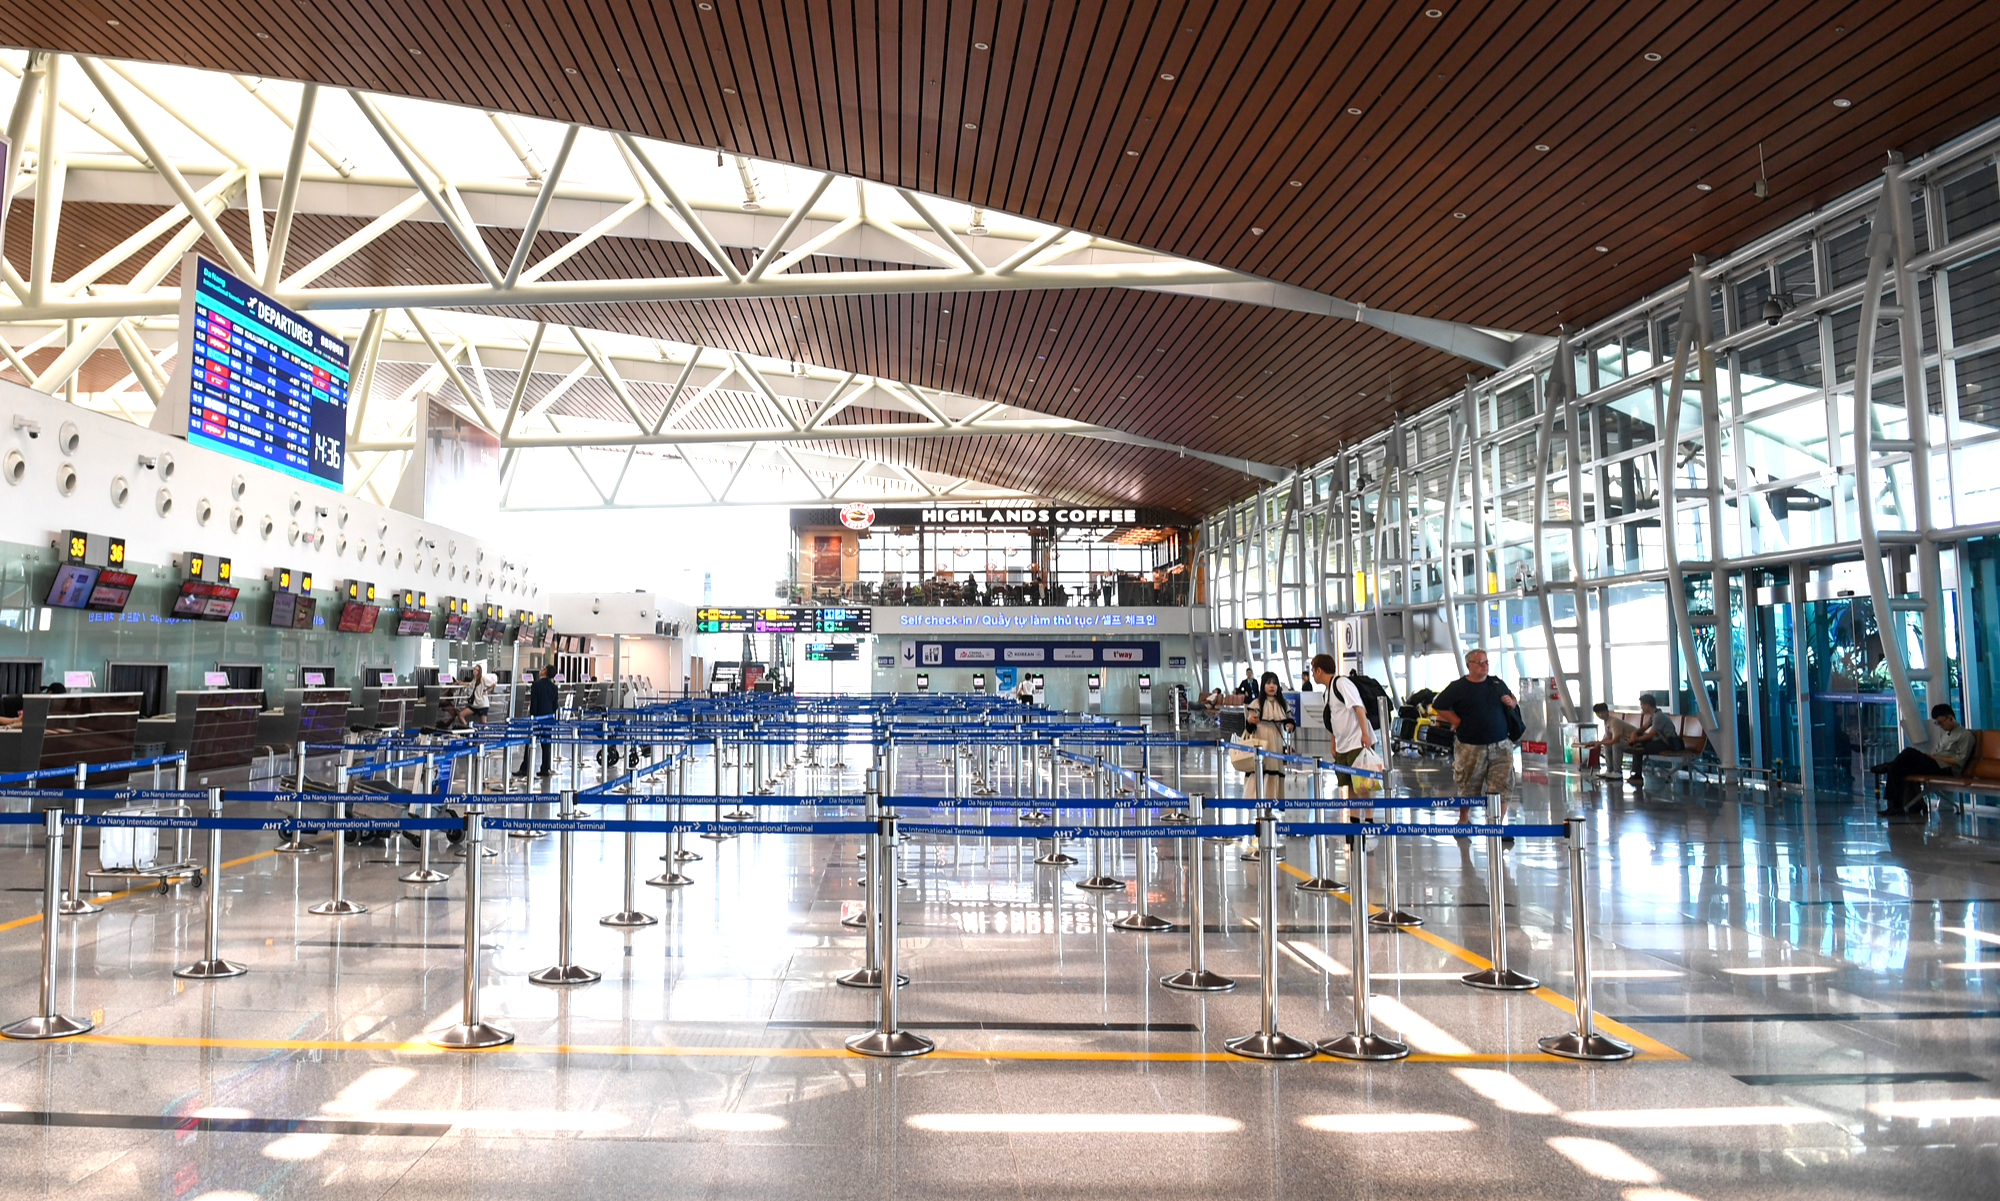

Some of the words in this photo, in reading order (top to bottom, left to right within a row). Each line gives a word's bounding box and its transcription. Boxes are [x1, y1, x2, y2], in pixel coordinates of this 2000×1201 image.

[211, 271, 226, 288] Nang
[257, 301, 313, 348] DEPARTURES
[314, 432, 341, 470] 14:36
[922, 509, 1050, 523] HIGHLANDS
[1055, 509, 1136, 523] COFFEE
[71, 537, 85, 557] 35
[110, 544, 124, 563] 36
[191, 558, 203, 575] 37
[219, 563, 230, 580] 38
[900, 614, 923, 626] Self
[924, 614, 973, 626] check-in
[974, 614, 980, 626] /
[982, 611, 1011, 629] Quầy
[1014, 614, 1029, 629] tự
[1030, 614, 1051, 626] làm
[1053, 613, 1072, 626] thủ
[1074, 614, 1094, 629] tục
[1094, 614, 1100, 626] /
[1101, 613, 1122, 627] 셀프
[1125, 613, 1156, 627] 체크인
[7, 790, 41, 798] International
[115, 791, 130, 801] AHT
[151, 792, 165, 800] Nang
[166, 792, 200, 801] International
[274, 794, 290, 802] AHT
[311, 794, 327, 803] Nang
[328, 794, 364, 802] International
[365, 794, 389, 802] Terminal
[444, 795, 460, 804] AHT
[472, 794, 480, 803] Da
[481, 794, 497, 804] Nang
[498, 794, 534, 803] International
[535, 793, 560, 802] Terminal
[627, 796, 643, 804] AHT
[655, 796, 663, 804] Da
[665, 796, 680, 806] Nang
[681, 796, 718, 805] International
[719, 796, 743, 805] Terminal
[799, 797, 816, 806] AHT
[829, 797, 836, 805] Da
[838, 797, 853, 806] Nang
[938, 799, 955, 807] AHT
[968, 798, 976, 806] Da
[977, 798, 993, 808] Nang
[994, 798, 1031, 807] International
[1032, 799, 1057, 807] Terminal
[1114, 800, 1131, 808] AHT
[1144, 799, 1152, 807] Da
[1154, 799, 1169, 809] Nang
[1255, 800, 1272, 809] AHT
[1284, 799, 1293, 807] Da
[1294, 799, 1310, 809] Nang
[1311, 799, 1347, 808] International
[1349, 799, 1374, 807] Terminal
[1431, 799, 1448, 807] AHT
[1460, 797, 1469, 805] Da
[1470, 797, 1485, 807] Nang
[63, 817, 83, 826] AHT
[97, 817, 106, 826] Da
[106, 818, 125, 829] Nang
[126, 818, 169, 829] International
[169, 819, 198, 830] Terminal
[263, 820, 282, 830] AHT
[297, 820, 306, 829] Da
[307, 820, 325, 831] Nang
[326, 820, 370, 830] International
[371, 821, 399, 830] Terminal
[502, 821, 512, 831] Da
[513, 821, 531, 833] Nang
[532, 822, 576, 832] International
[577, 823, 606, 833] Terminal
[673, 824, 692, 834] AHT
[707, 824, 716, 833] Da
[718, 824, 736, 835] Nang
[738, 824, 783, 834] International
[783, 825, 813, 834] Terminal
[909, 826, 953, 836] International
[954, 828, 984, 837] Terminal
[1053, 830, 1073, 839] AHT
[1089, 829, 1099, 838] Da
[1100, 829, 1119, 840] Nang
[1121, 828, 1165, 838] International
[1166, 828, 1197, 837] Terminal
[1361, 826, 1381, 836] AHT
[1397, 825, 1406, 835] Da
[1408, 825, 1426, 837] Nang
[1428, 825, 1472, 835] International
[1474, 825, 1504, 835] Terminal
